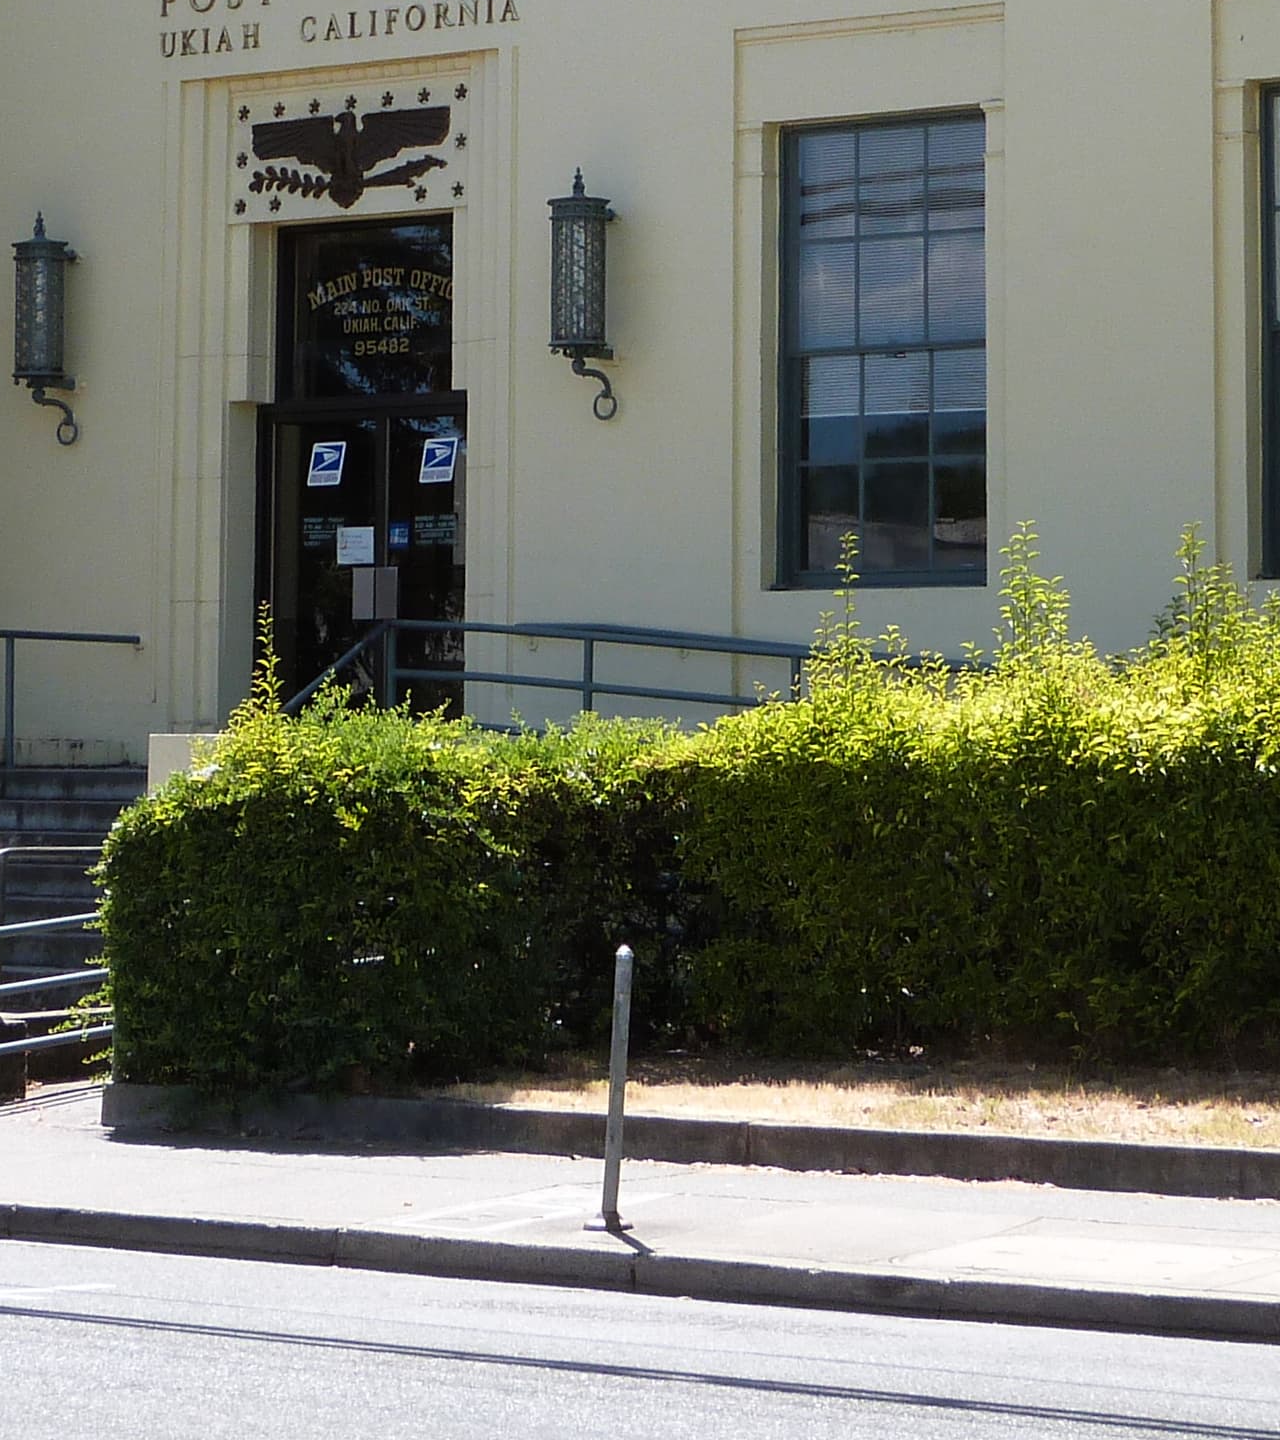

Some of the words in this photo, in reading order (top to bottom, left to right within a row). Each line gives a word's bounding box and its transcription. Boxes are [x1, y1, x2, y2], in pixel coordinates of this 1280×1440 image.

[160, 22, 260, 58] UKIAH
[307, 271, 358, 311] MAIN
[361, 267, 404, 289] POST
[410, 269, 453, 299] OFFIC
[333, 300, 357, 316] 224
[385, 296, 411, 313] OAK
[354, 337, 410, 356] 95482
